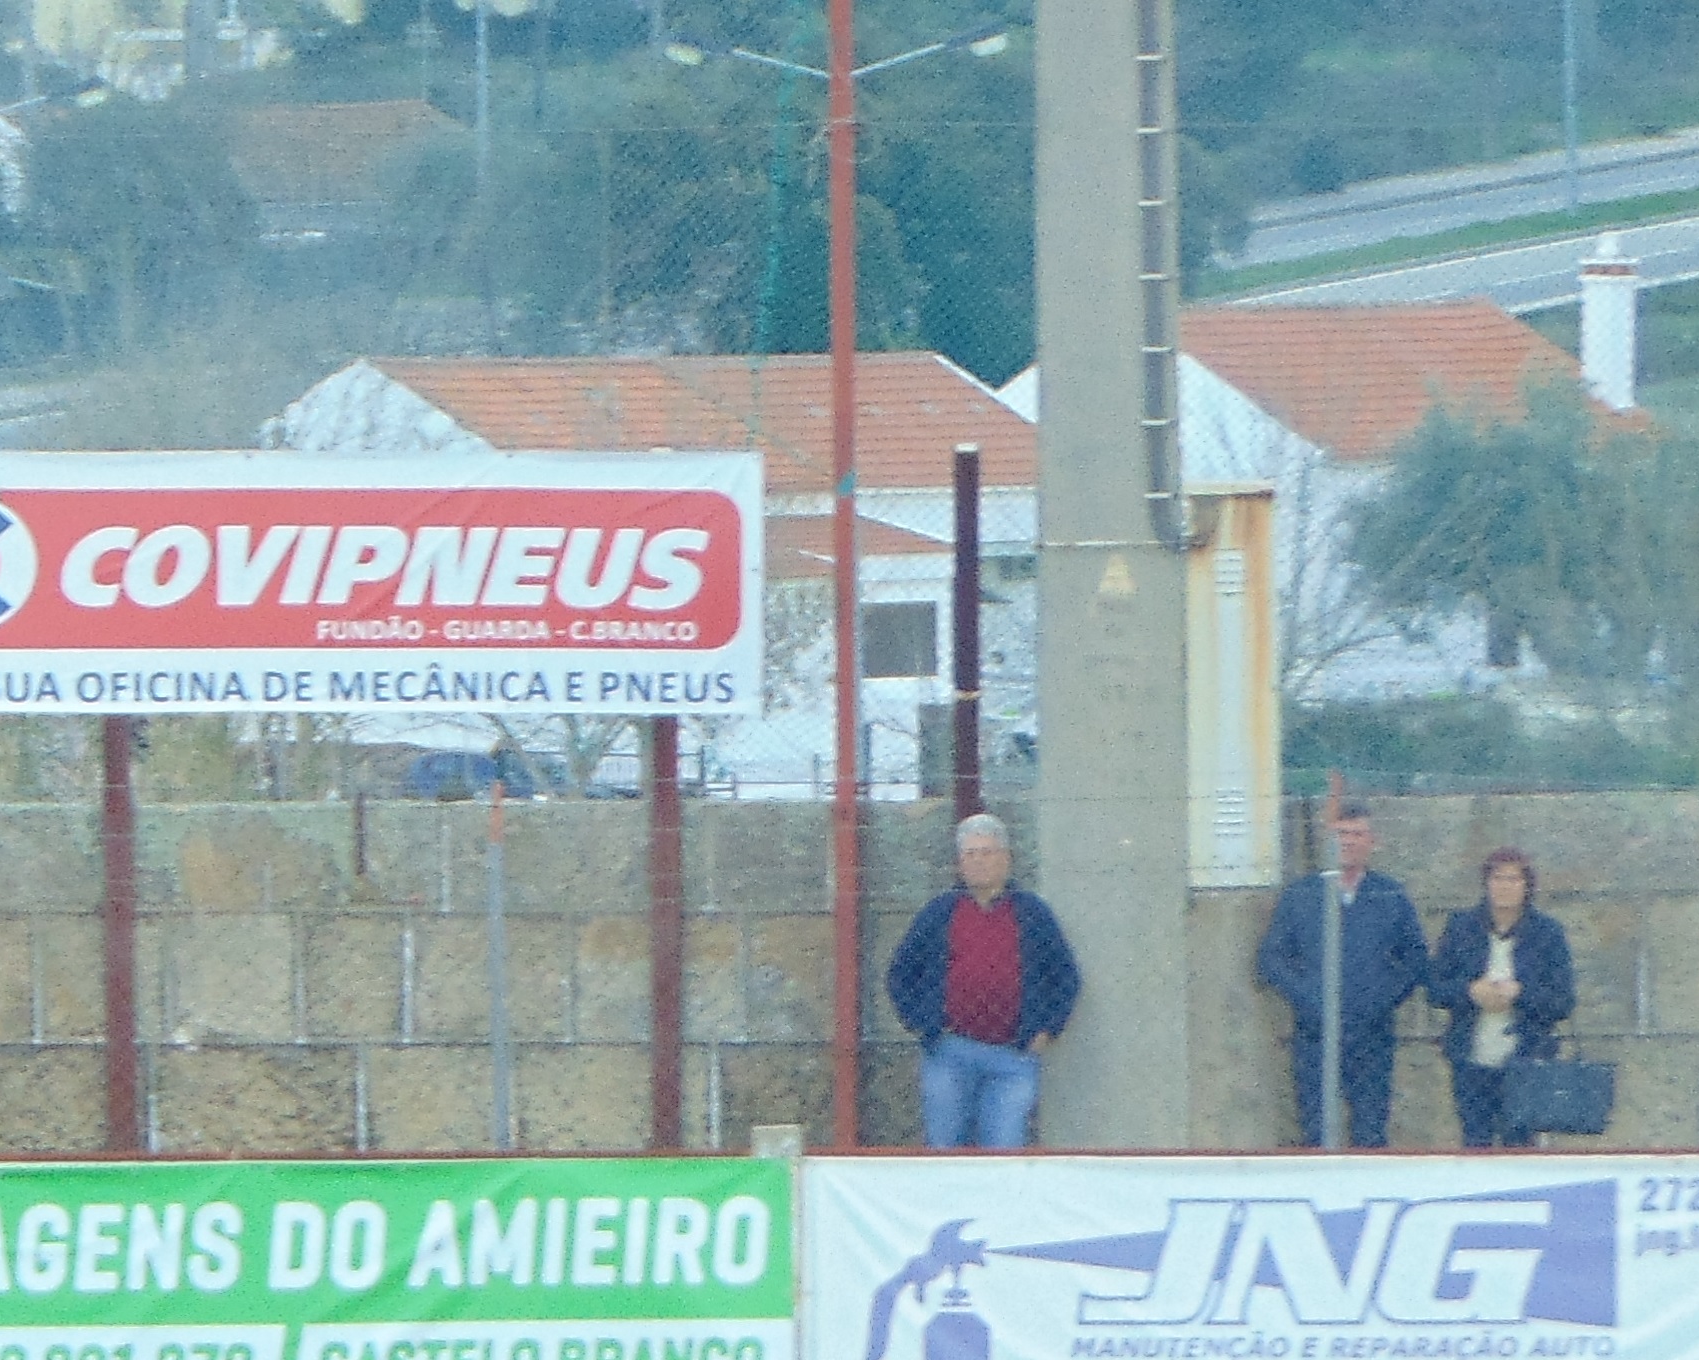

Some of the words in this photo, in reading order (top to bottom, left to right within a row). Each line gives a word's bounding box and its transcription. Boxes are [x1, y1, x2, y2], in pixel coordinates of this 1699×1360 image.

[60, 524, 710, 611] COVIPNEUS
[316, 615, 423, 642] FUNDÃO
[442, 619, 550, 642] GUARDA
[570, 619, 699, 642] C.BRANCO
[76, 670, 249, 703] OFICINA
[263, 670, 314, 702] DE
[328, 662, 550, 702] MECÂNICA
[566, 670, 583, 702] E
[600, 670, 736, 703] PNEUS
[267, 1199, 389, 1291] DO
[406, 1194, 772, 1288] AMIEIRO
[1078, 1198, 1553, 1326] JNG
[1301, 1337, 1321, 1358] E
[1527, 1336, 1617, 1358] AUTO
